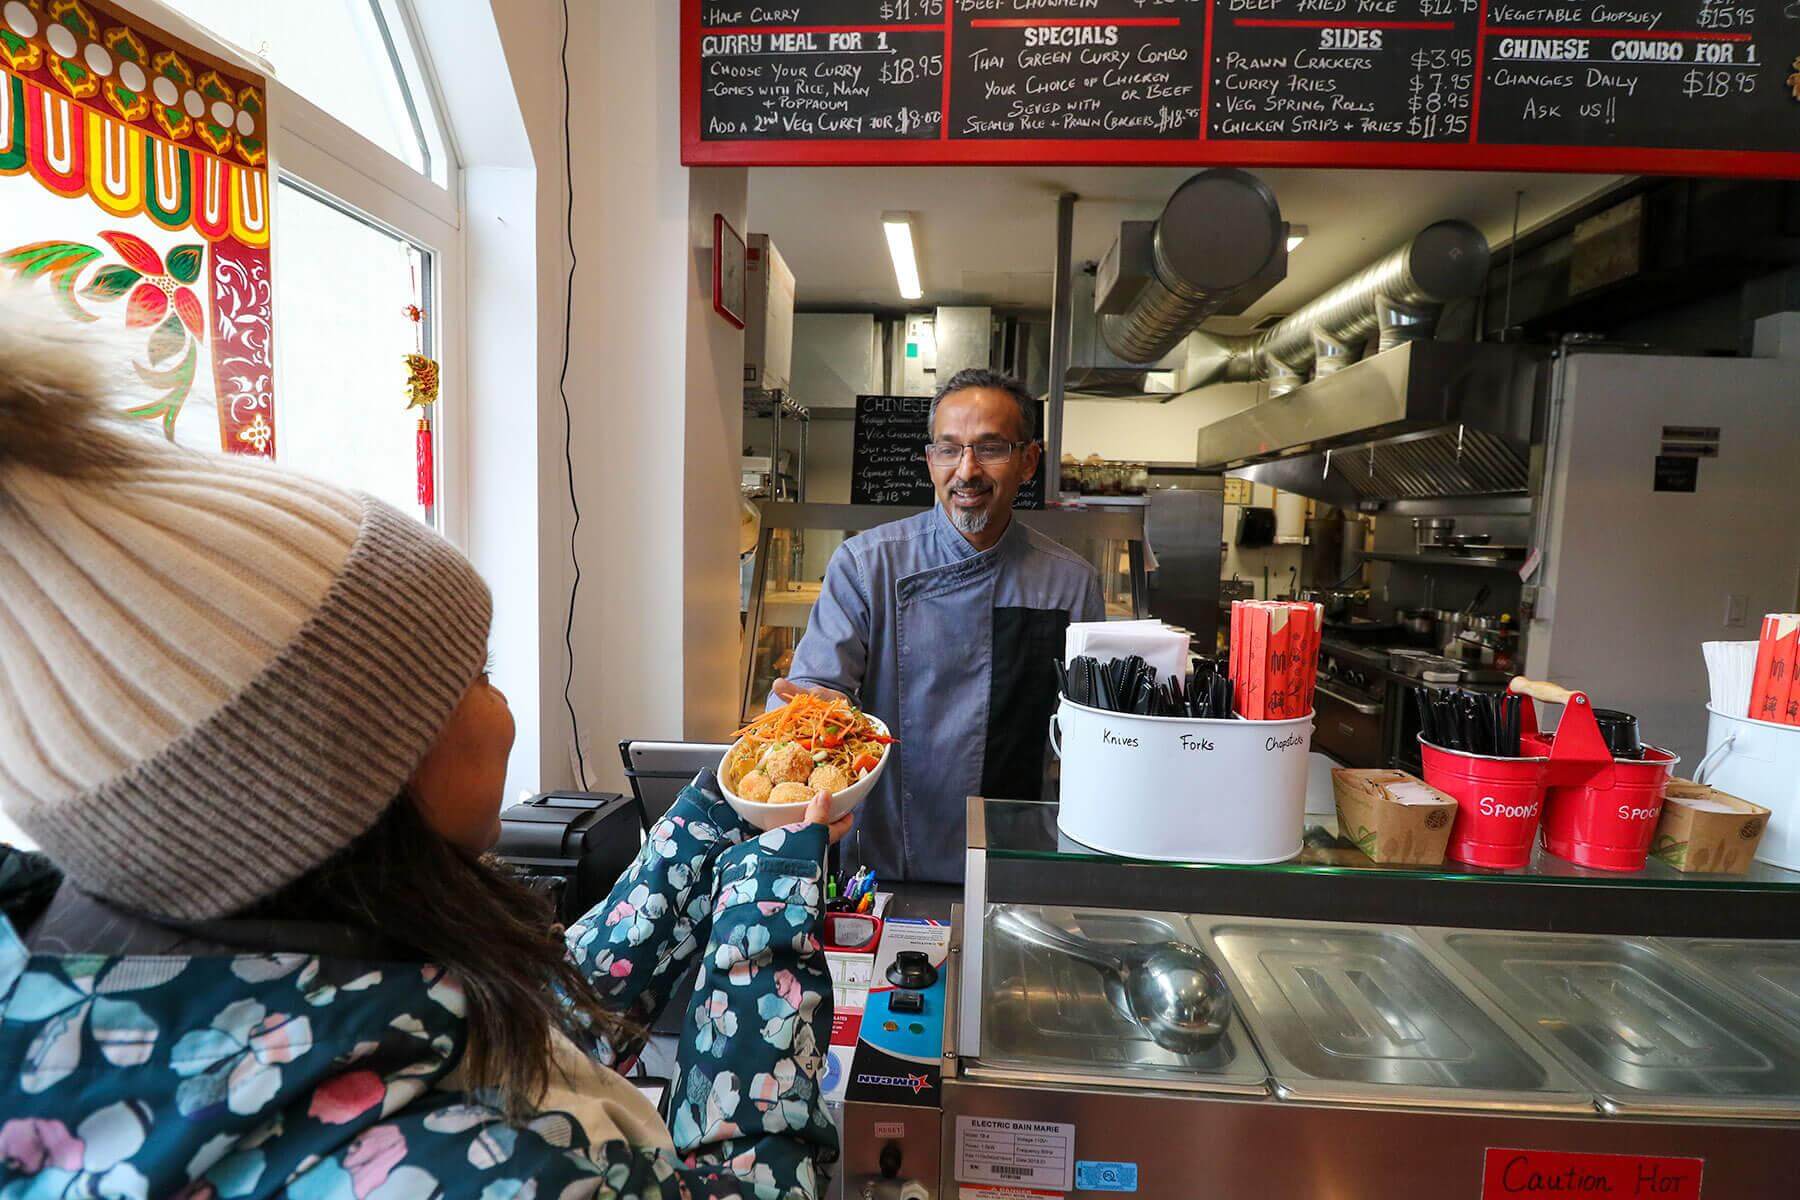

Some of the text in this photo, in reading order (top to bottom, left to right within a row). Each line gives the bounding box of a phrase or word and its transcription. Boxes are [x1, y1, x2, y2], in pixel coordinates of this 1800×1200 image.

[709, 0, 943, 24] HALF CURRY $11.95
[1358, 0, 1396, 13] RICE
[1494, 5, 1755, 30] VEGETABLE CHOPSUEY $15.95
[702, 32, 889, 55] CURRY MEAL FOR 1
[1024, 26, 1119, 47] SPECIALS
[1320, 28, 1383, 49] SIDES
[968, 43, 1188, 72] THAI GREEN CURRY COMBO
[1226, 48, 1473, 71] PRAWN CRACKERS $3.95
[1500, 38, 1756, 63] CHINESE COMBO FOR 1
[710, 61, 862, 88] CHOOSE YOUR CURRY
[878, 55, 943, 85] $18.95
[985, 80, 1016, 99] YOUR
[1026, 75, 1076, 93] CHOICE
[1103, 68, 1169, 87] CHICKEN
[1121, 84, 1193, 100] OR BEEF
[1225, 74, 1280, 95] CURRY
[1288, 76, 1337, 92] FRIES
[1494, 68, 1638, 96] CHANGES DAILY
[1682, 68, 1759, 98] $18.95
[1067, 98, 1101, 110] WITH
[1226, 96, 1257, 112] VEG
[1263, 96, 1325, 112] SPRING
[1331, 94, 1375, 112] ROLLS
[1522, 98, 1561, 120] ASK
[708, 116, 736, 134] ADD
[739, 121, 748, 133] A
[783, 115, 814, 134] VEG
[818, 113, 863, 134] CURRY
[1222, 118, 1285, 134] CHICKEN
[1291, 116, 1339, 133] STRIPS
[1360, 117, 1403, 133] FRIES
[1406, 114, 1468, 138] $11.95
[863, 397, 929, 413] CHINESE
[1103, 728, 1140, 749] Knives
[1180, 734, 1215, 751] Forks
[1479, 797, 1539, 818] SPOONS
[971, 1119, 1060, 1133] ELECTRIC BAIN MARIE
[1502, 1155, 1612, 1193] Caution
